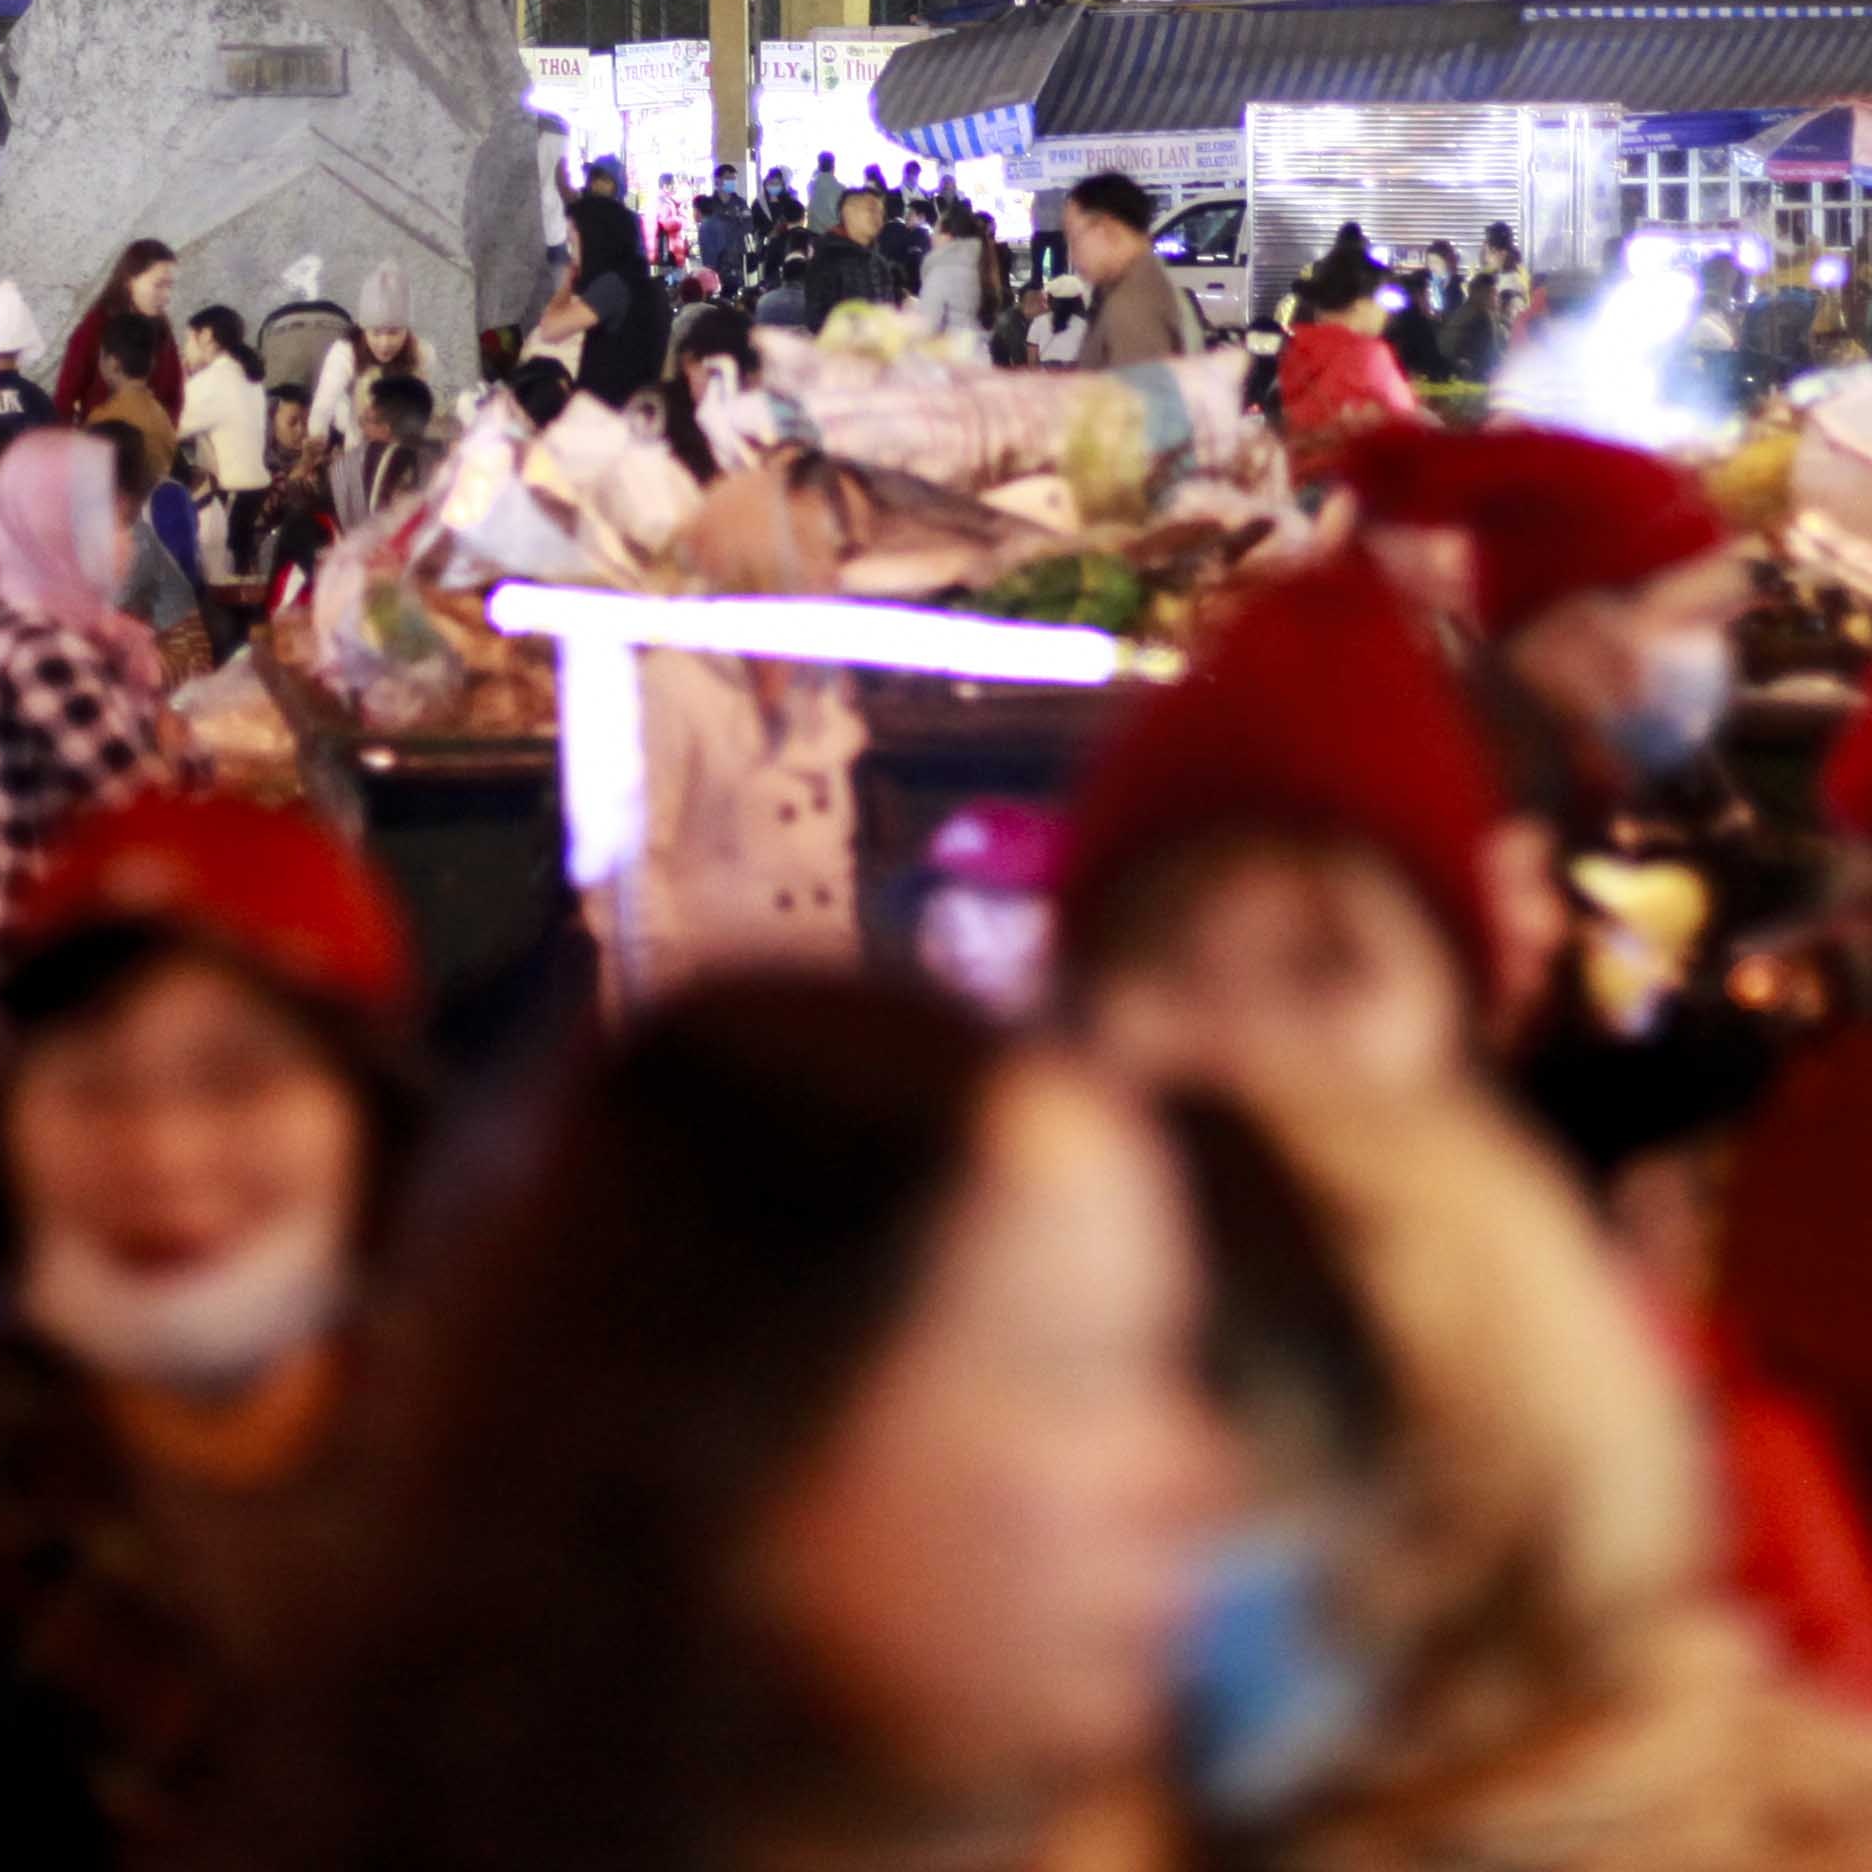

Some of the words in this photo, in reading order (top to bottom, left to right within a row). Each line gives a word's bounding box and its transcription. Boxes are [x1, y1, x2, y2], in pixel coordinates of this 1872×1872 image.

[539, 57, 582, 76] THOA
[1085, 143, 1153, 173] PHƯƠNG
[1158, 145, 1191, 170] LAN
